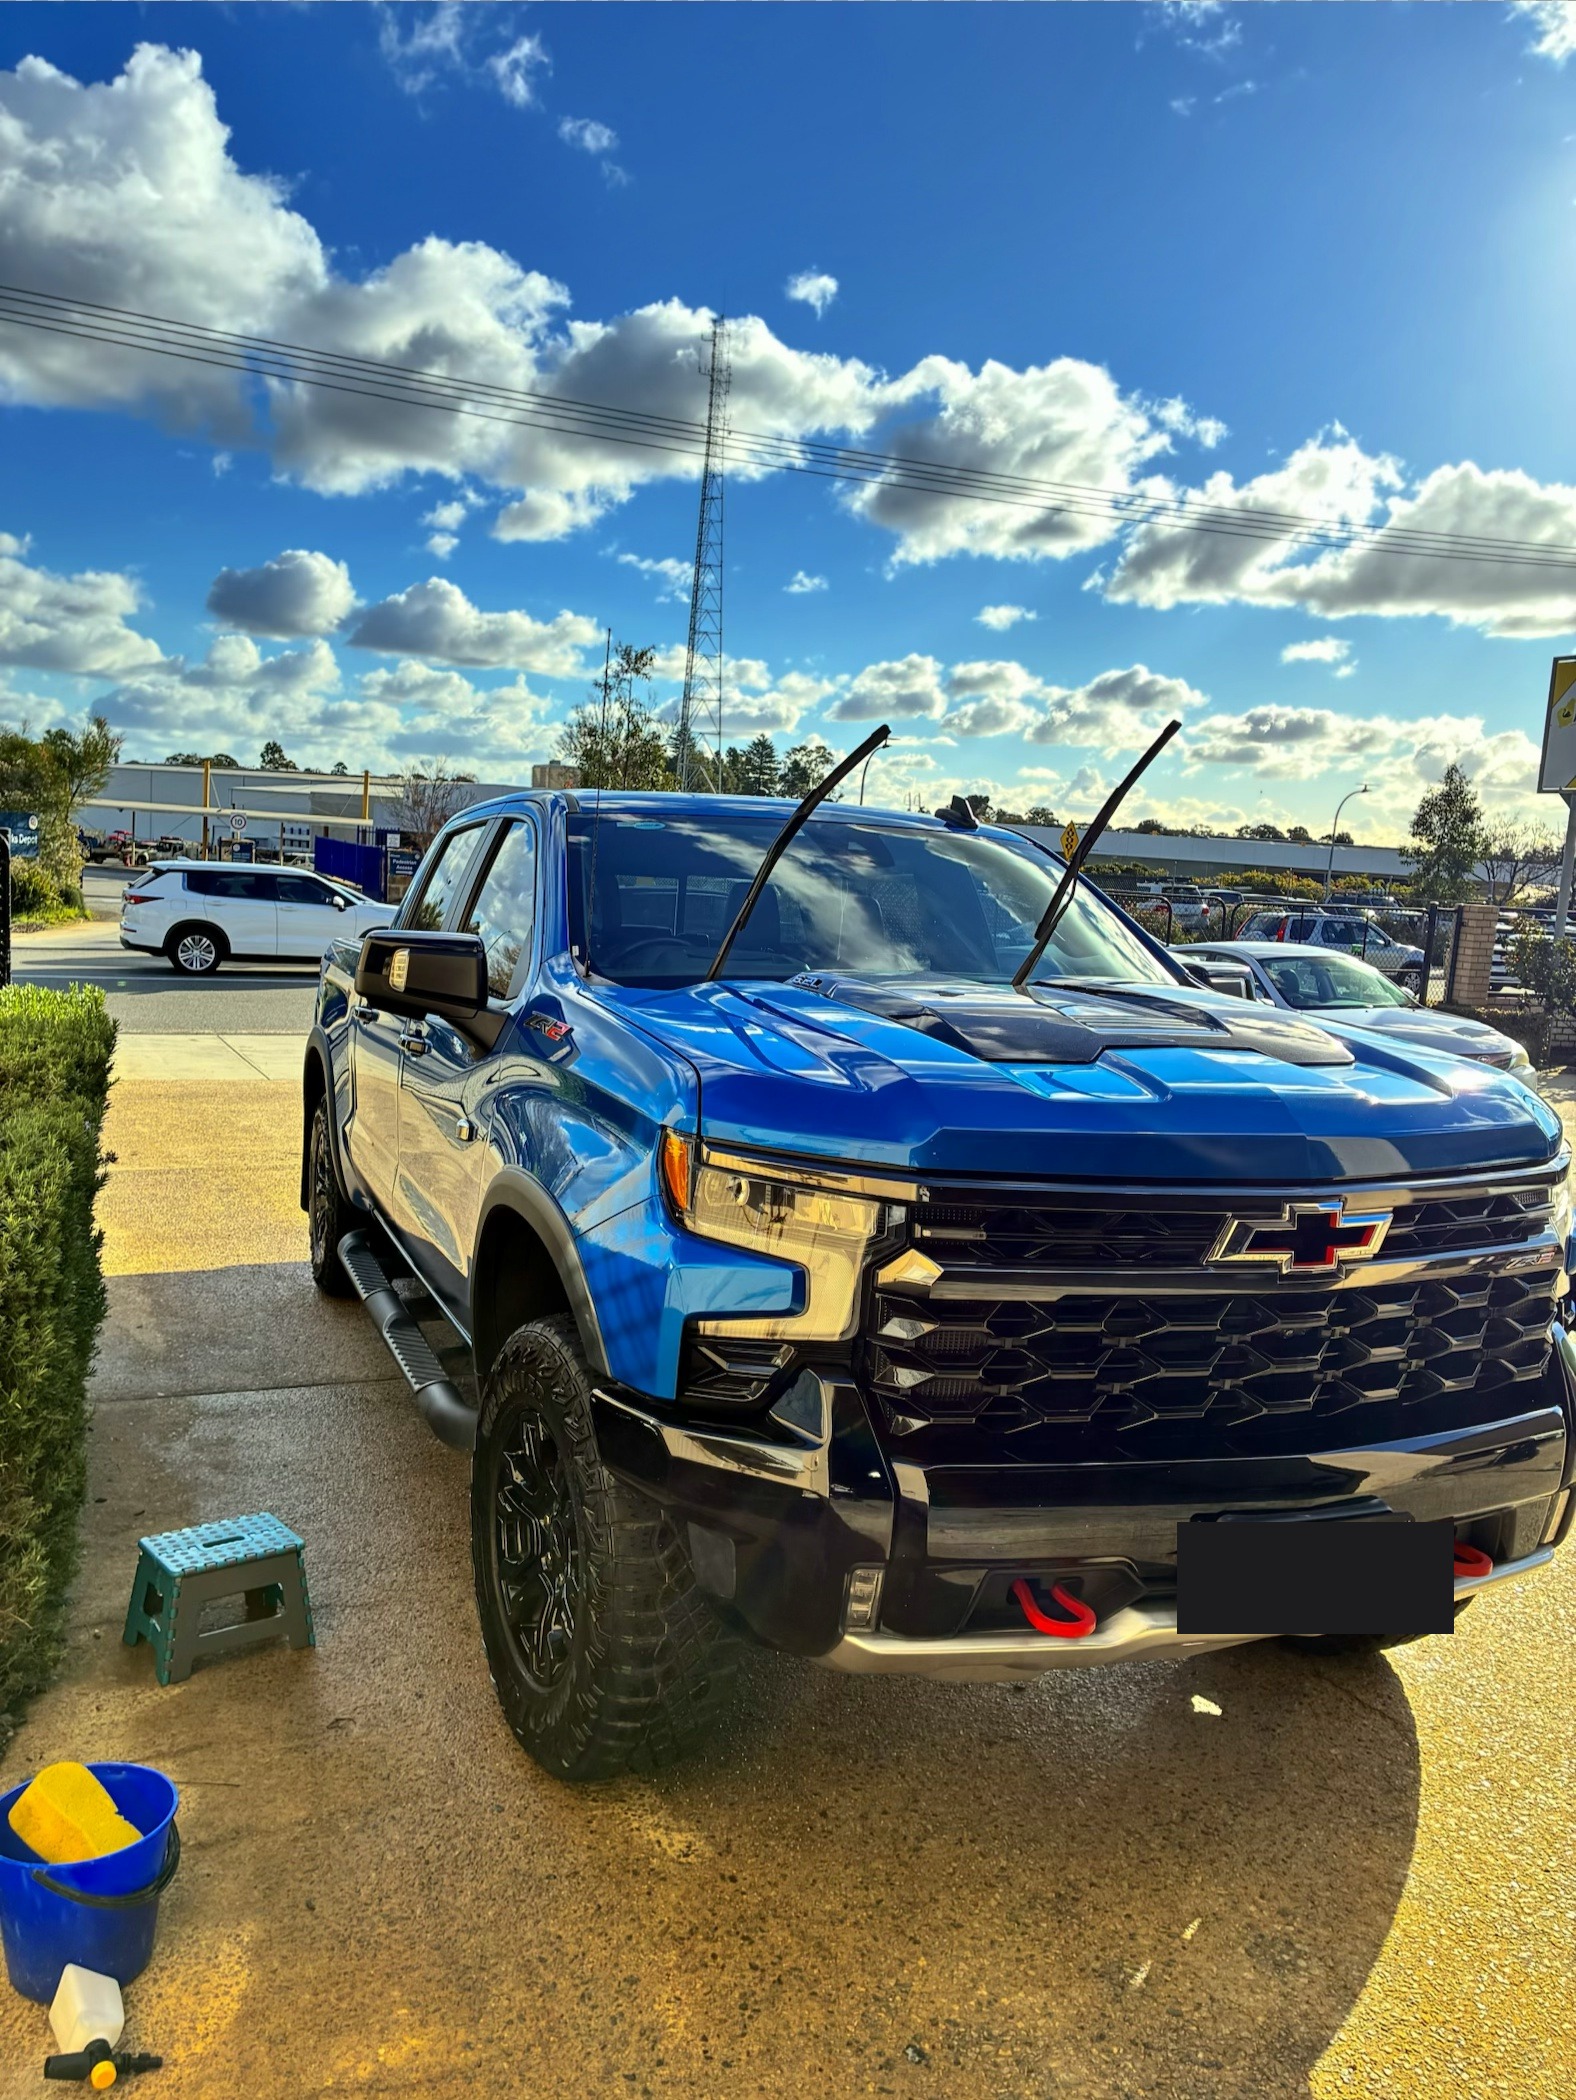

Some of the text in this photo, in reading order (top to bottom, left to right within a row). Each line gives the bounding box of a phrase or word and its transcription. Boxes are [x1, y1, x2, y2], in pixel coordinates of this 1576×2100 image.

[234, 818, 243, 826] 10
[19, 834, 38, 846] Depot
[523, 1010, 572, 1042] ZR2
[1505, 1251, 1556, 1270] ZR2
